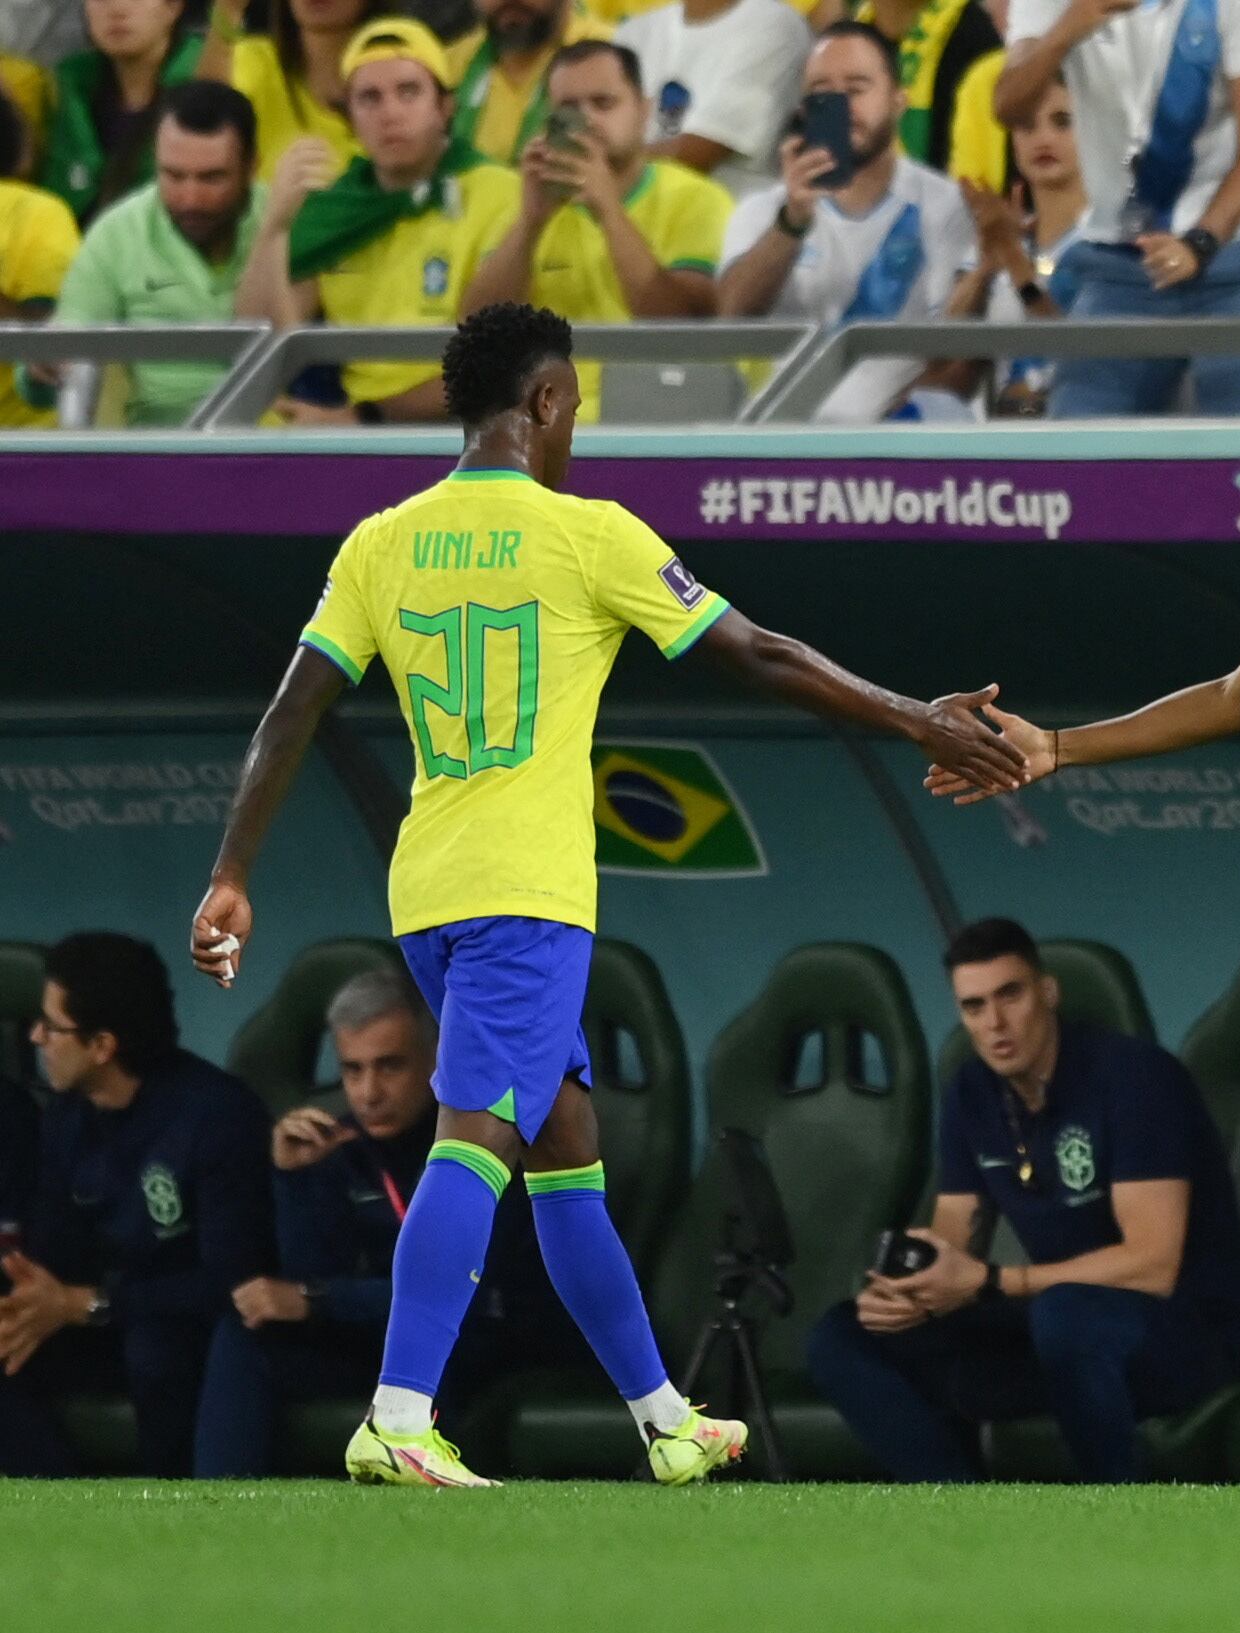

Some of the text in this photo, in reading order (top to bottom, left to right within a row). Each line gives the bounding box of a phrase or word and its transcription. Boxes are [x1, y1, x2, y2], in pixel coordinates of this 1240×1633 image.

[699, 477, 1072, 541] #FIFAWorldCup
[413, 530, 522, 569] VINI JR
[398, 600, 539, 781] 20
